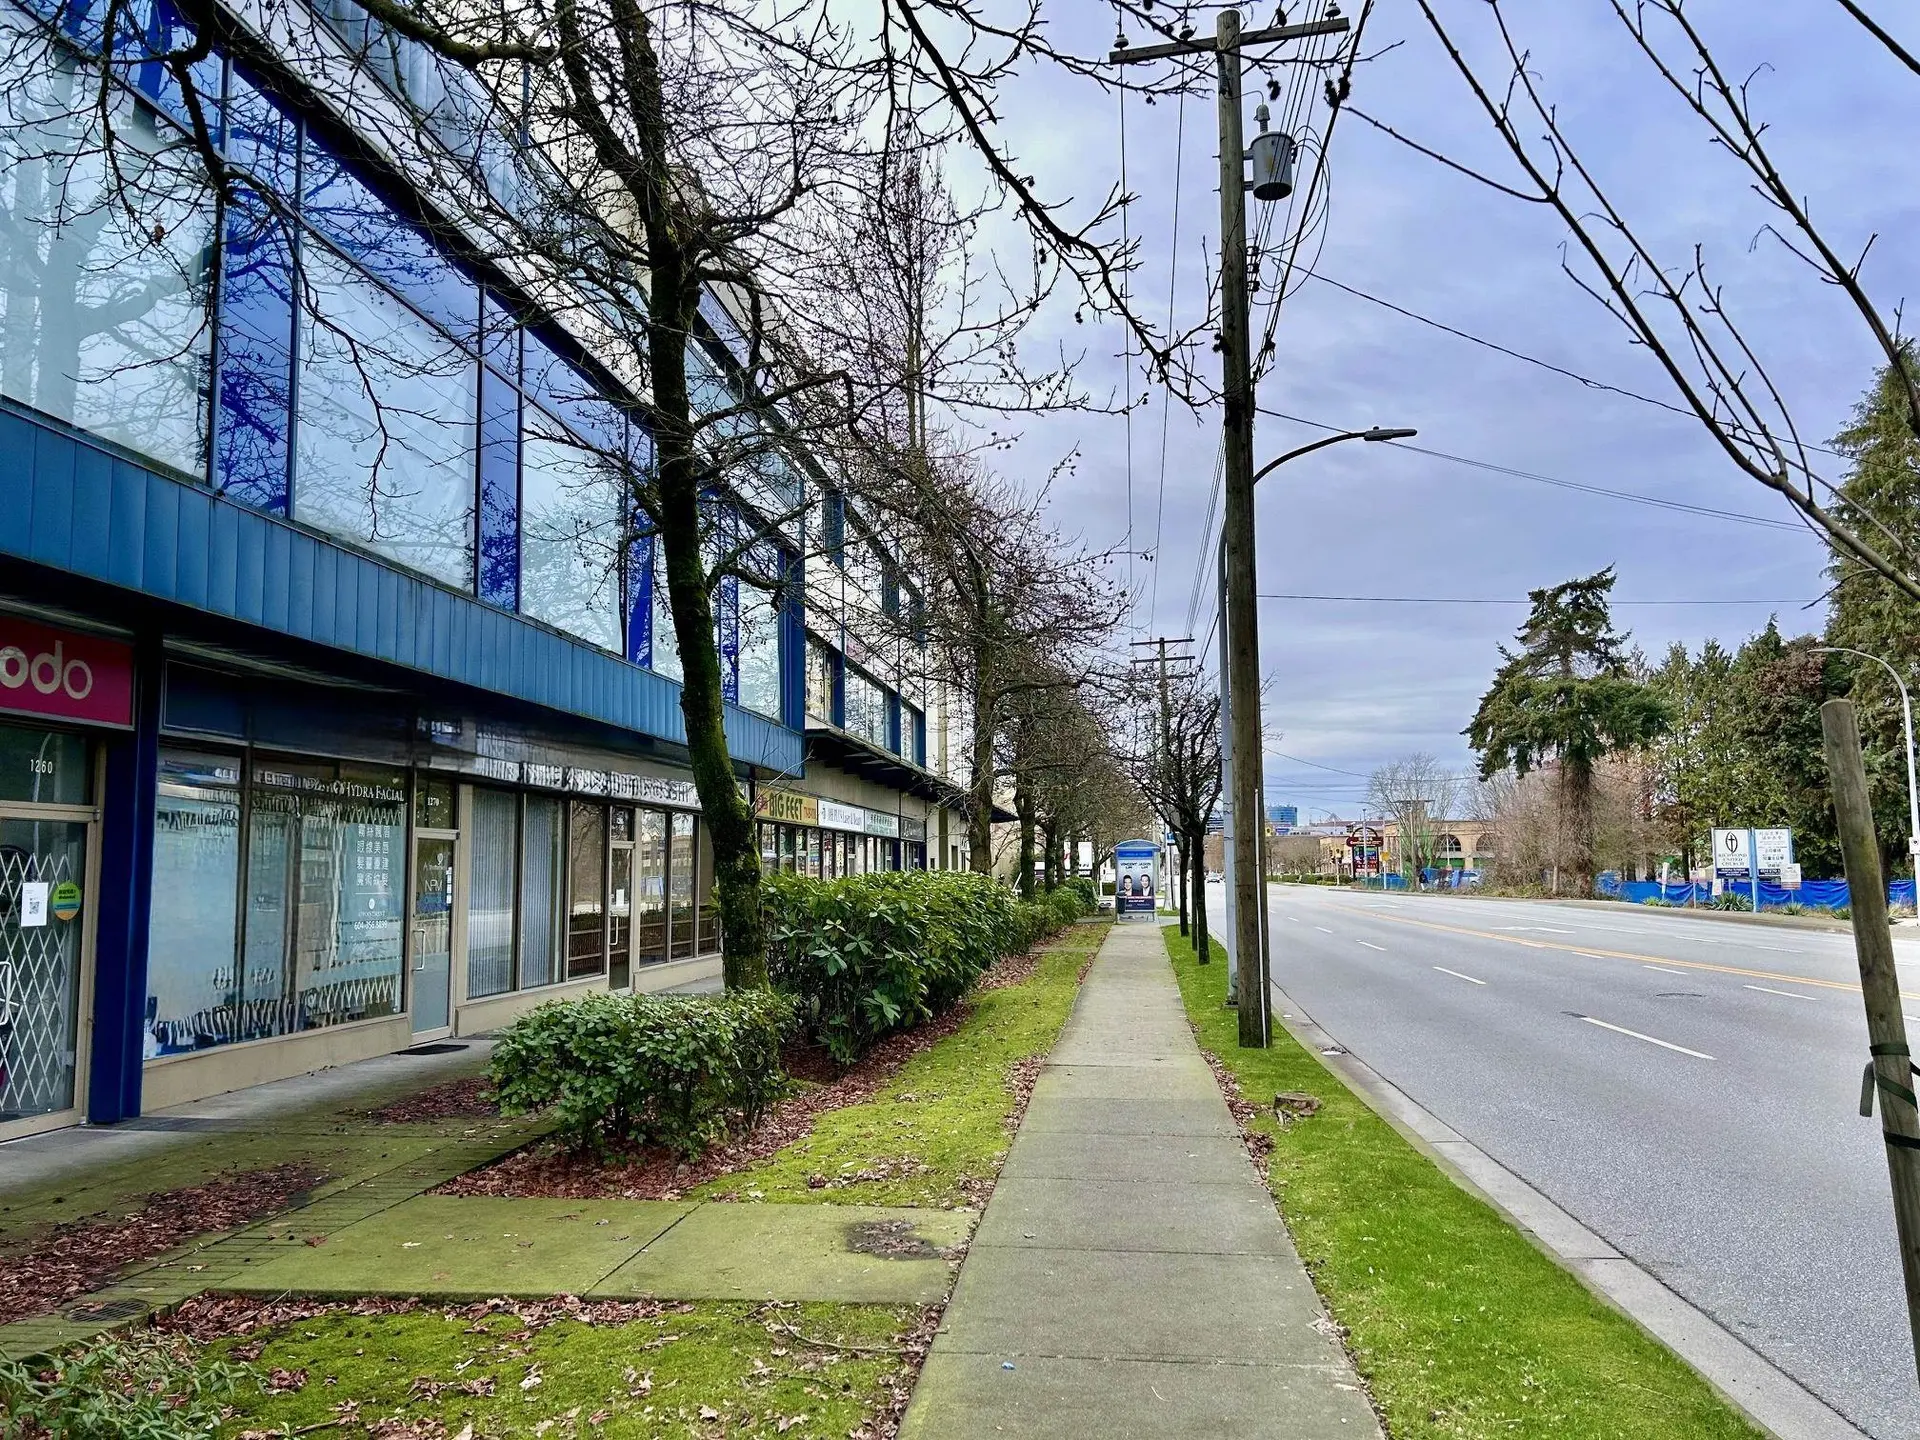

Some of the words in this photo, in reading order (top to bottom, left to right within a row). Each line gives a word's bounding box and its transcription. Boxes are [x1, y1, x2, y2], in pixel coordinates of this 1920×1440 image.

[30, 758, 53, 774] 1260
[375, 784, 405, 802] FACIAL
[769, 792, 785, 818] BIG
[785, 796, 803, 821] FEET
